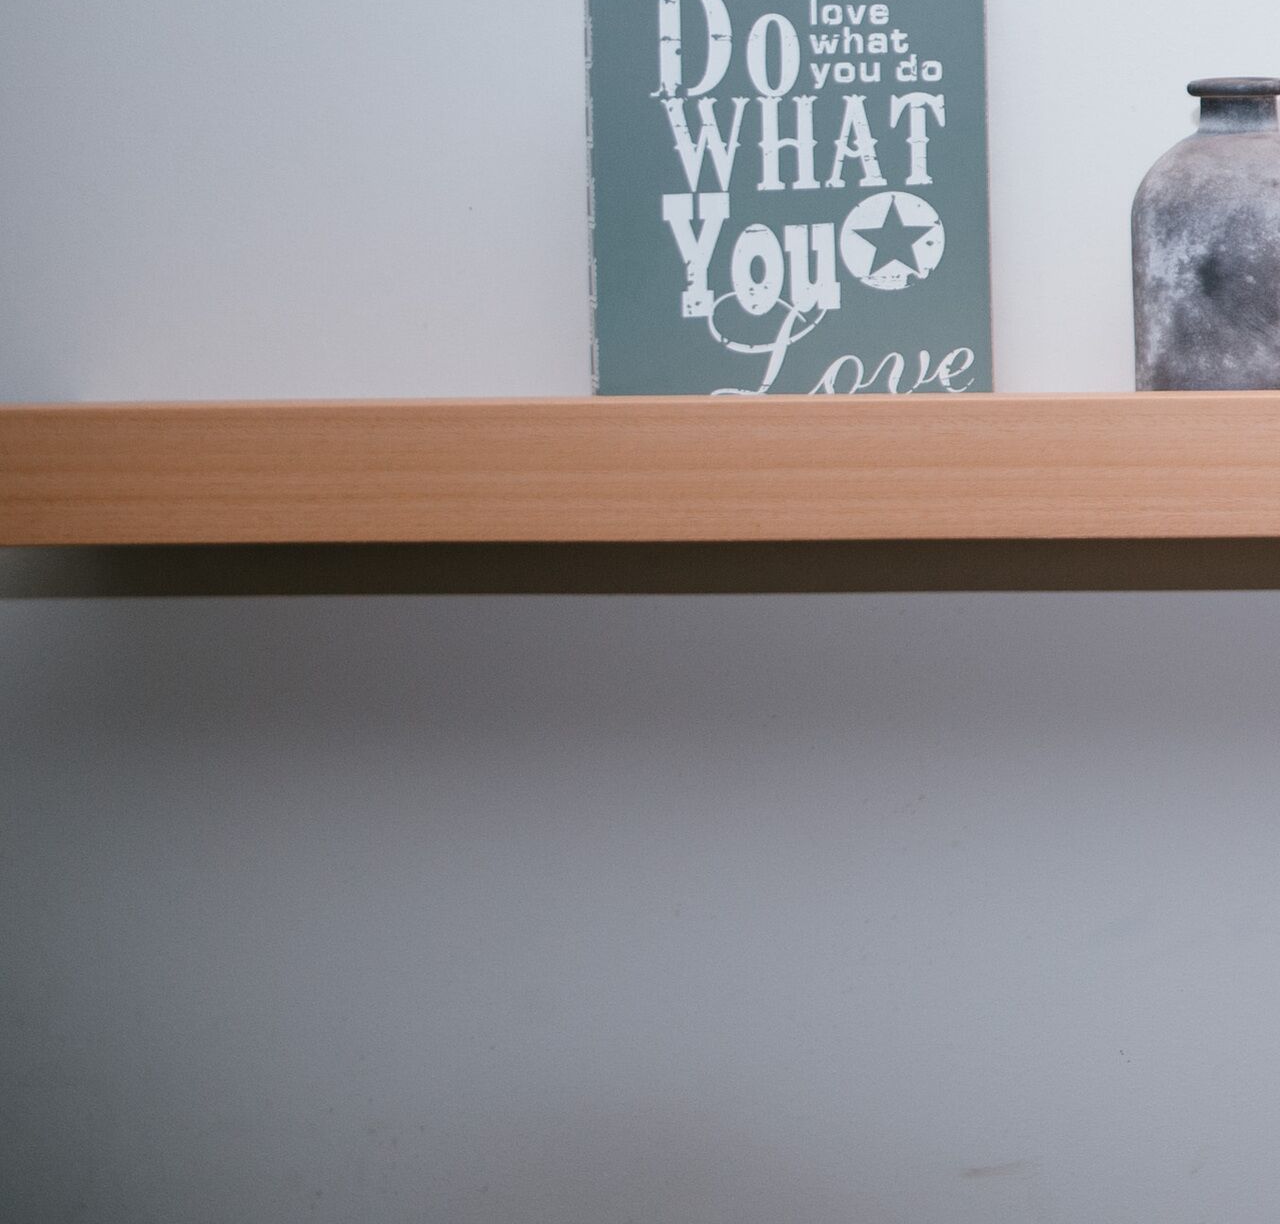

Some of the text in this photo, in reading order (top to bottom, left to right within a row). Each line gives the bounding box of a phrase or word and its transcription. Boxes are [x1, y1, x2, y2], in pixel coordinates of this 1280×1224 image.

[809, 27, 910, 55] what
[809, 54, 943, 89] you do
[660, 92, 946, 193] WHAT
[662, 192, 841, 318] You
[708, 292, 975, 395] Love
